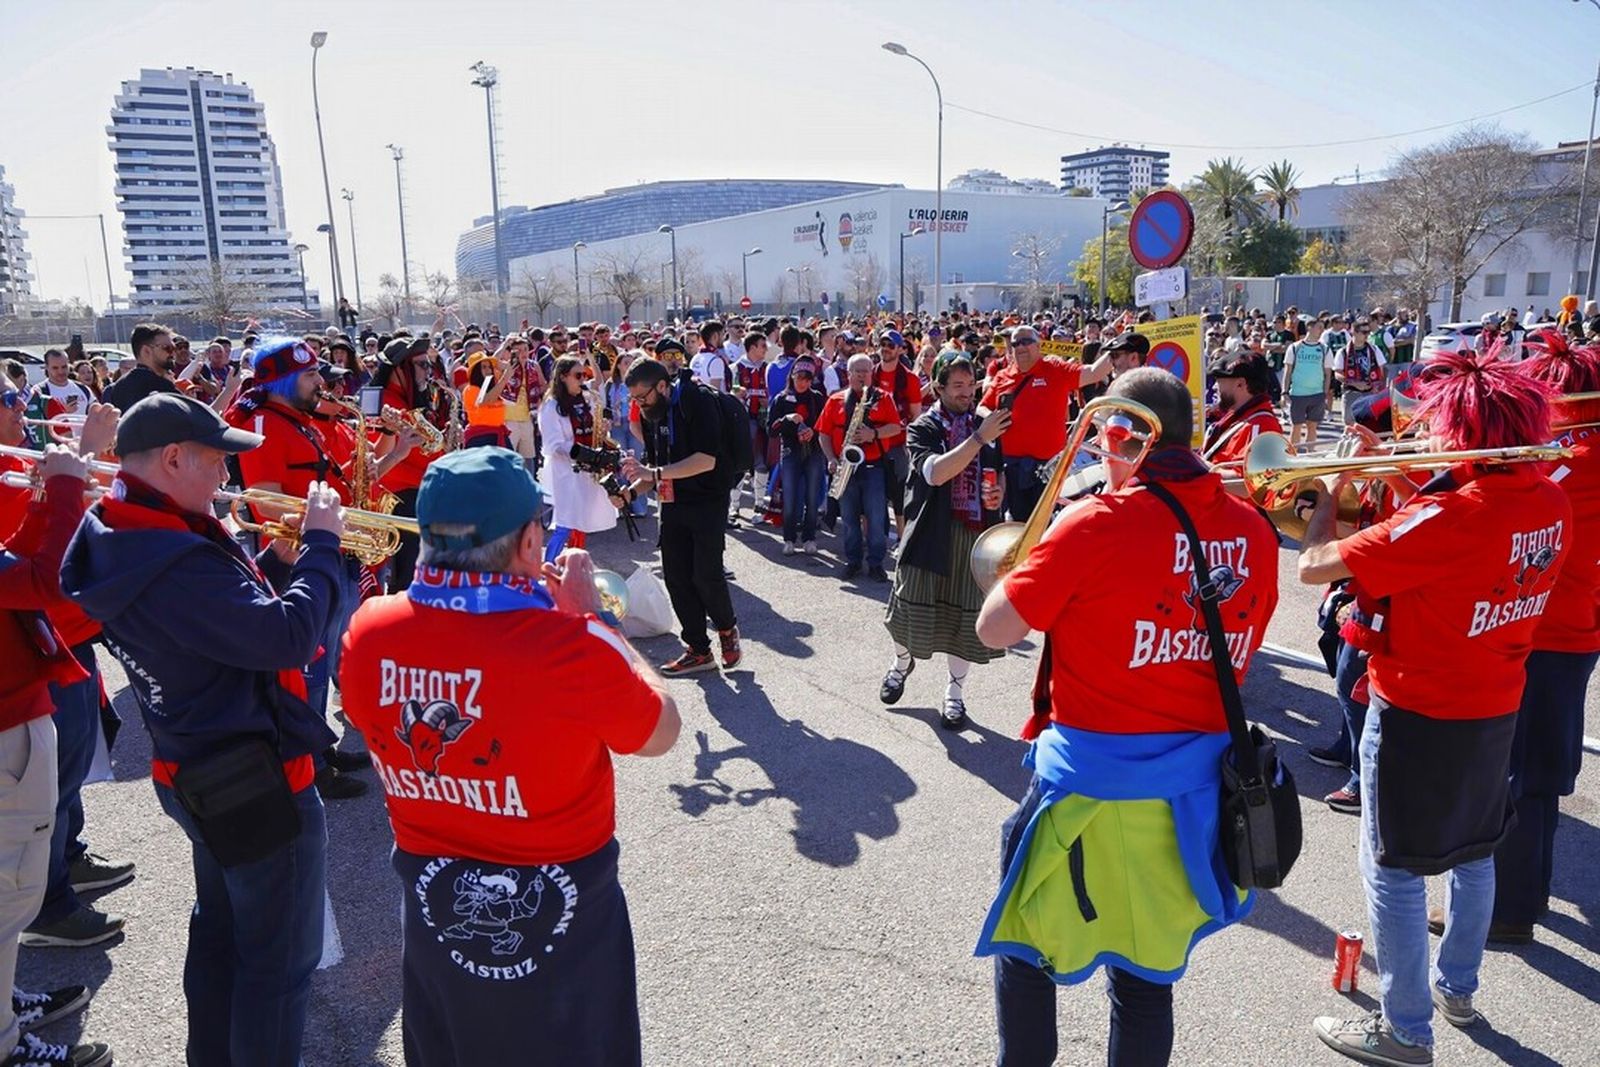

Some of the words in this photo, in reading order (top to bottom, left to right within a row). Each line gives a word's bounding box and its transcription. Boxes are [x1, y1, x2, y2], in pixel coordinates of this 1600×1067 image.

[1508, 520, 1563, 565] BIHOTZ
[378, 658, 483, 719] BIHOTZ
[450, 949, 538, 980] GASTEIZ
